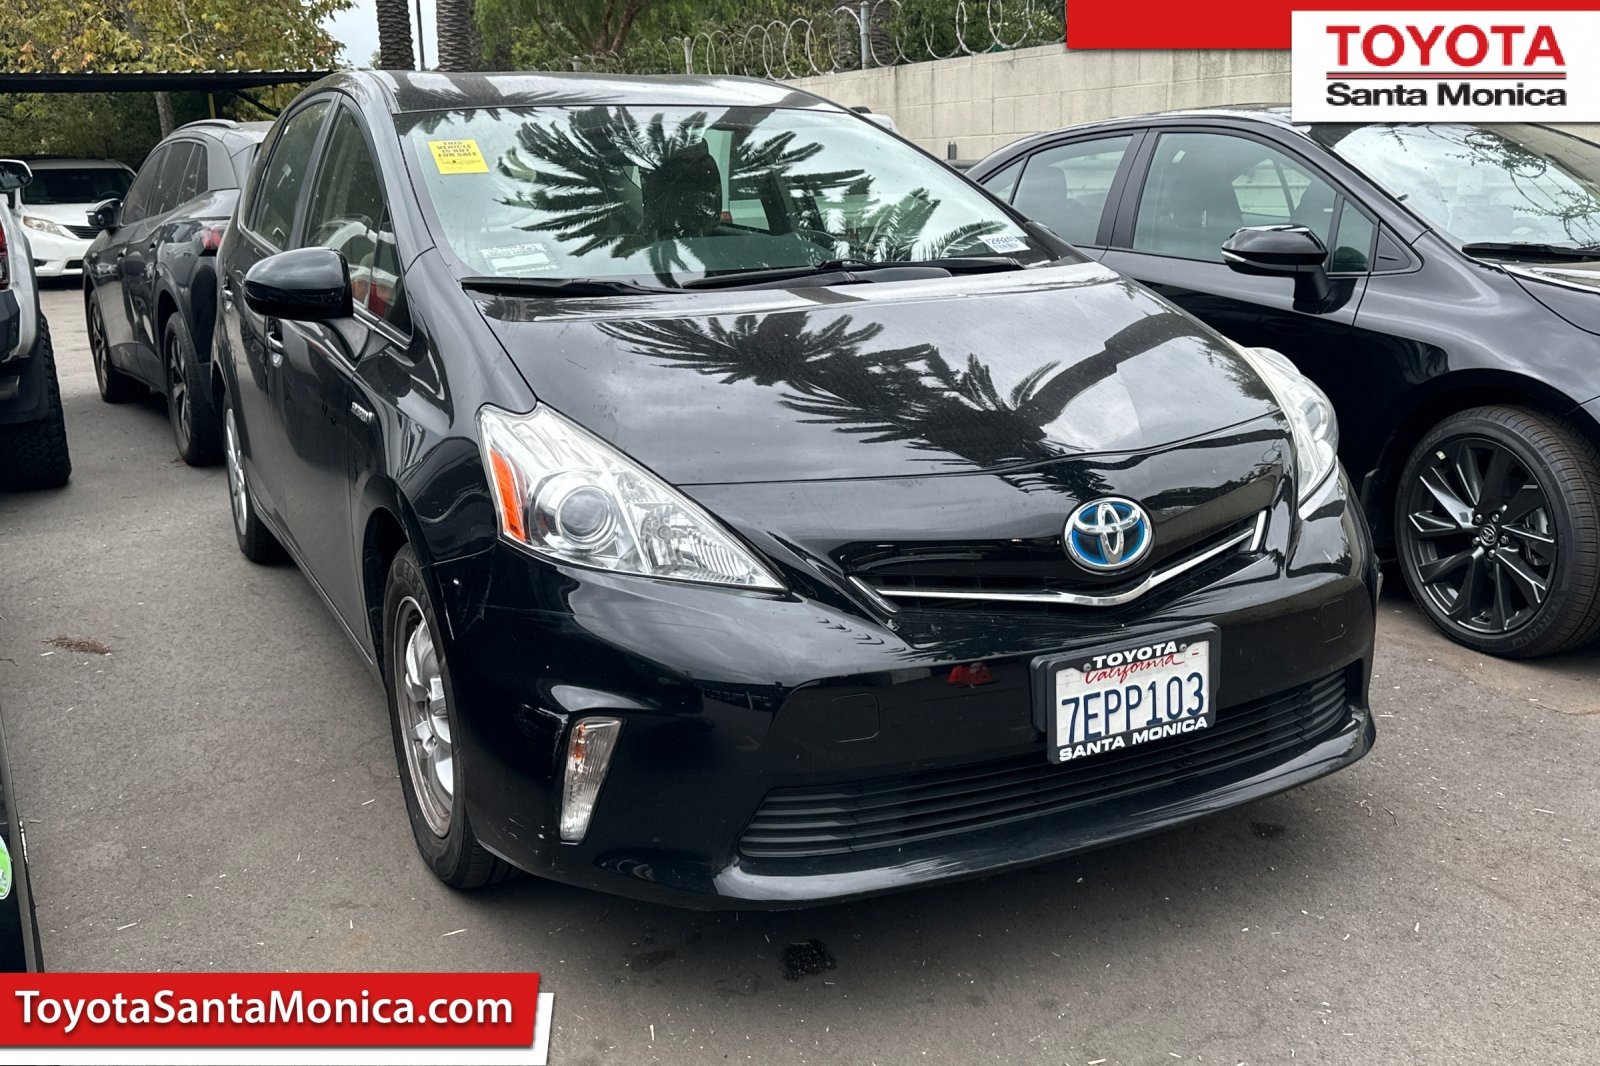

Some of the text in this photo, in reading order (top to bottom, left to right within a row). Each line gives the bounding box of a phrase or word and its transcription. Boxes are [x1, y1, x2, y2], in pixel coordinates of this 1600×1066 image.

[1084, 653, 1185, 684] California
[1093, 641, 1178, 669] TOYOTA
[1061, 672, 1204, 744] 7EPP103
[1059, 717, 1208, 762] SANTA MONICA
